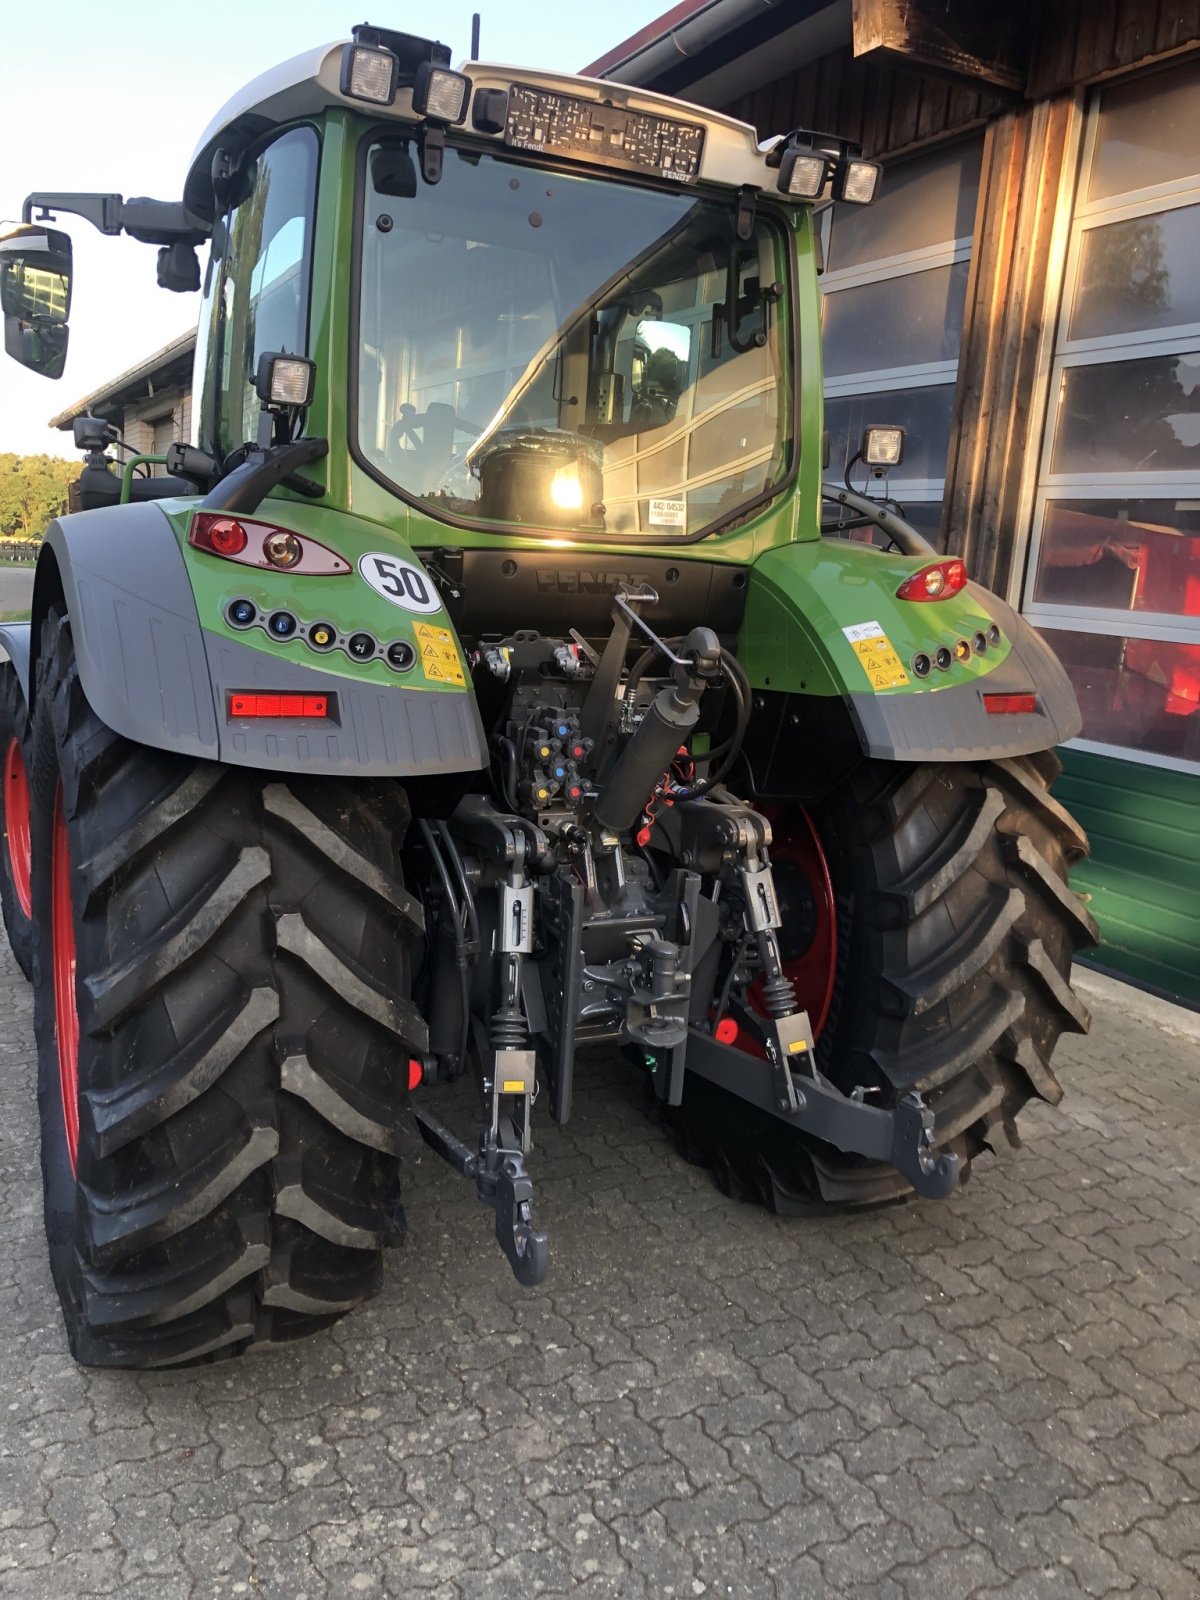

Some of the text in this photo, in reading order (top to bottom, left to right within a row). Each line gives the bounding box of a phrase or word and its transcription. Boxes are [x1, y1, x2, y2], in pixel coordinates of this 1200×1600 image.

[523, 140, 545, 152] Fendt
[662, 169, 692, 182] FENDT
[373, 558, 430, 604] 50
